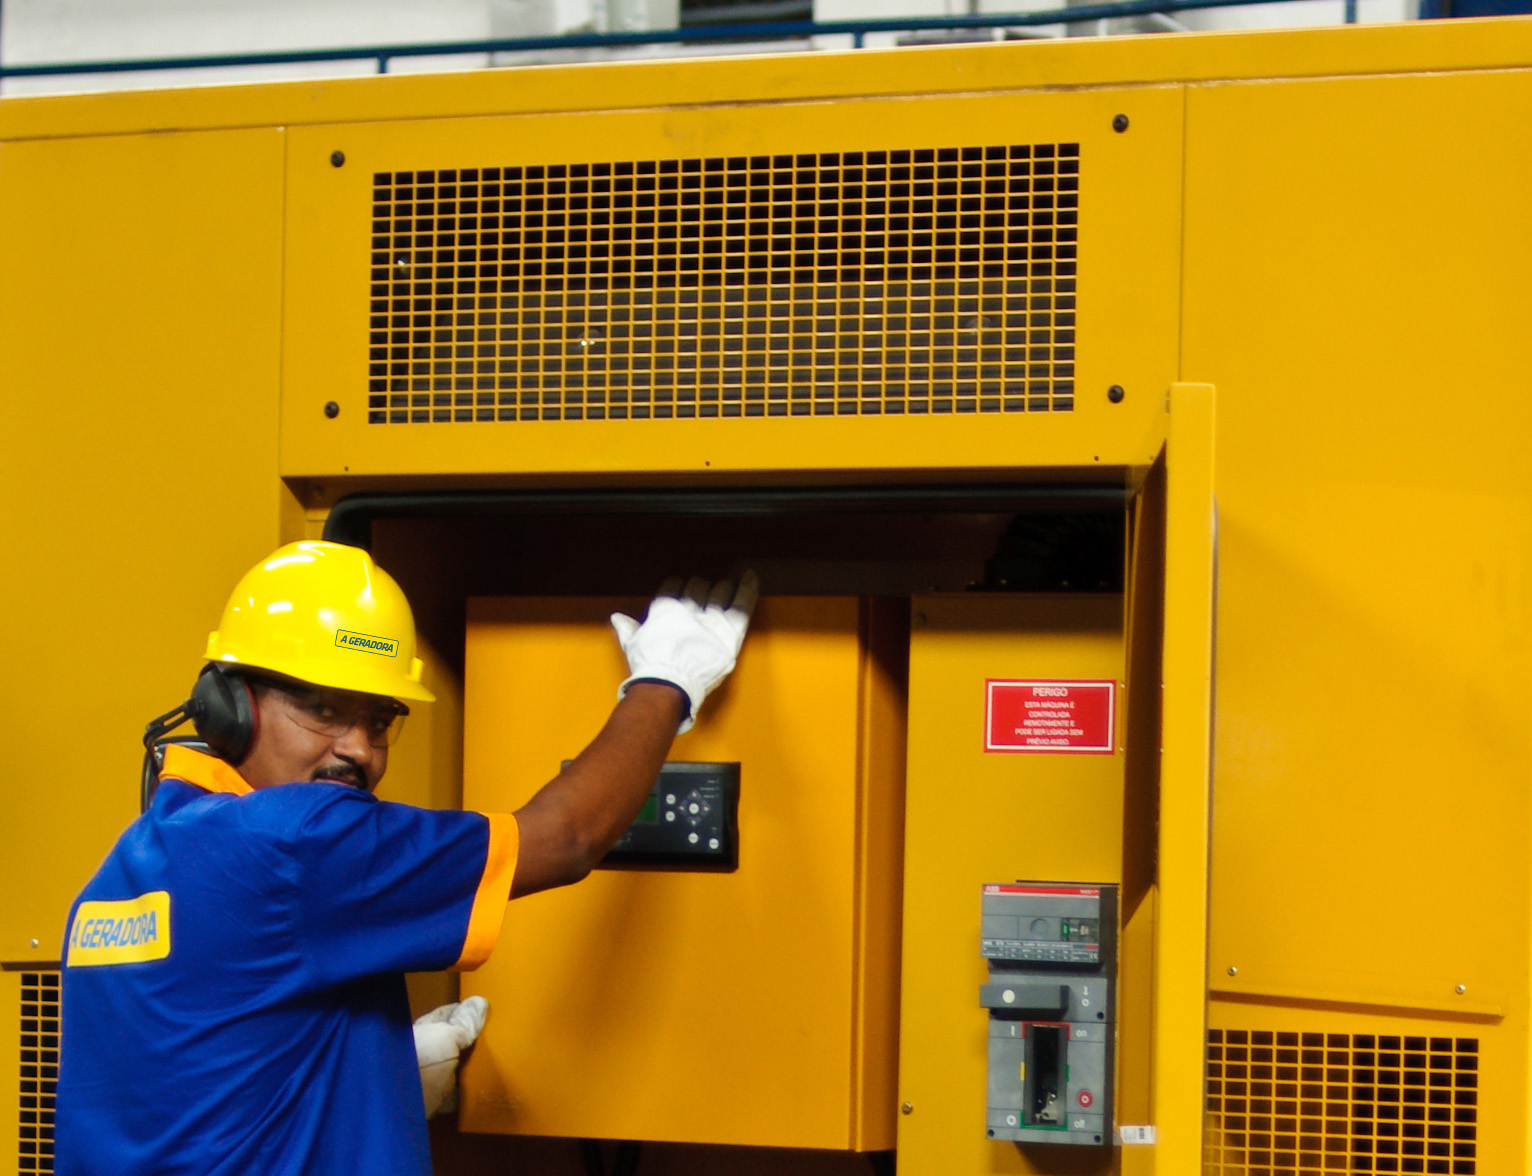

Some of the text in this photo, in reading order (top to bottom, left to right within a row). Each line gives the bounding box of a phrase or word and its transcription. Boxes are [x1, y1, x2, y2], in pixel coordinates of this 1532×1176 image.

[339, 635, 394, 652] A GERADORA
[1032, 687, 1069, 697] PERIGO
[80, 910, 158, 948] GERADORA
